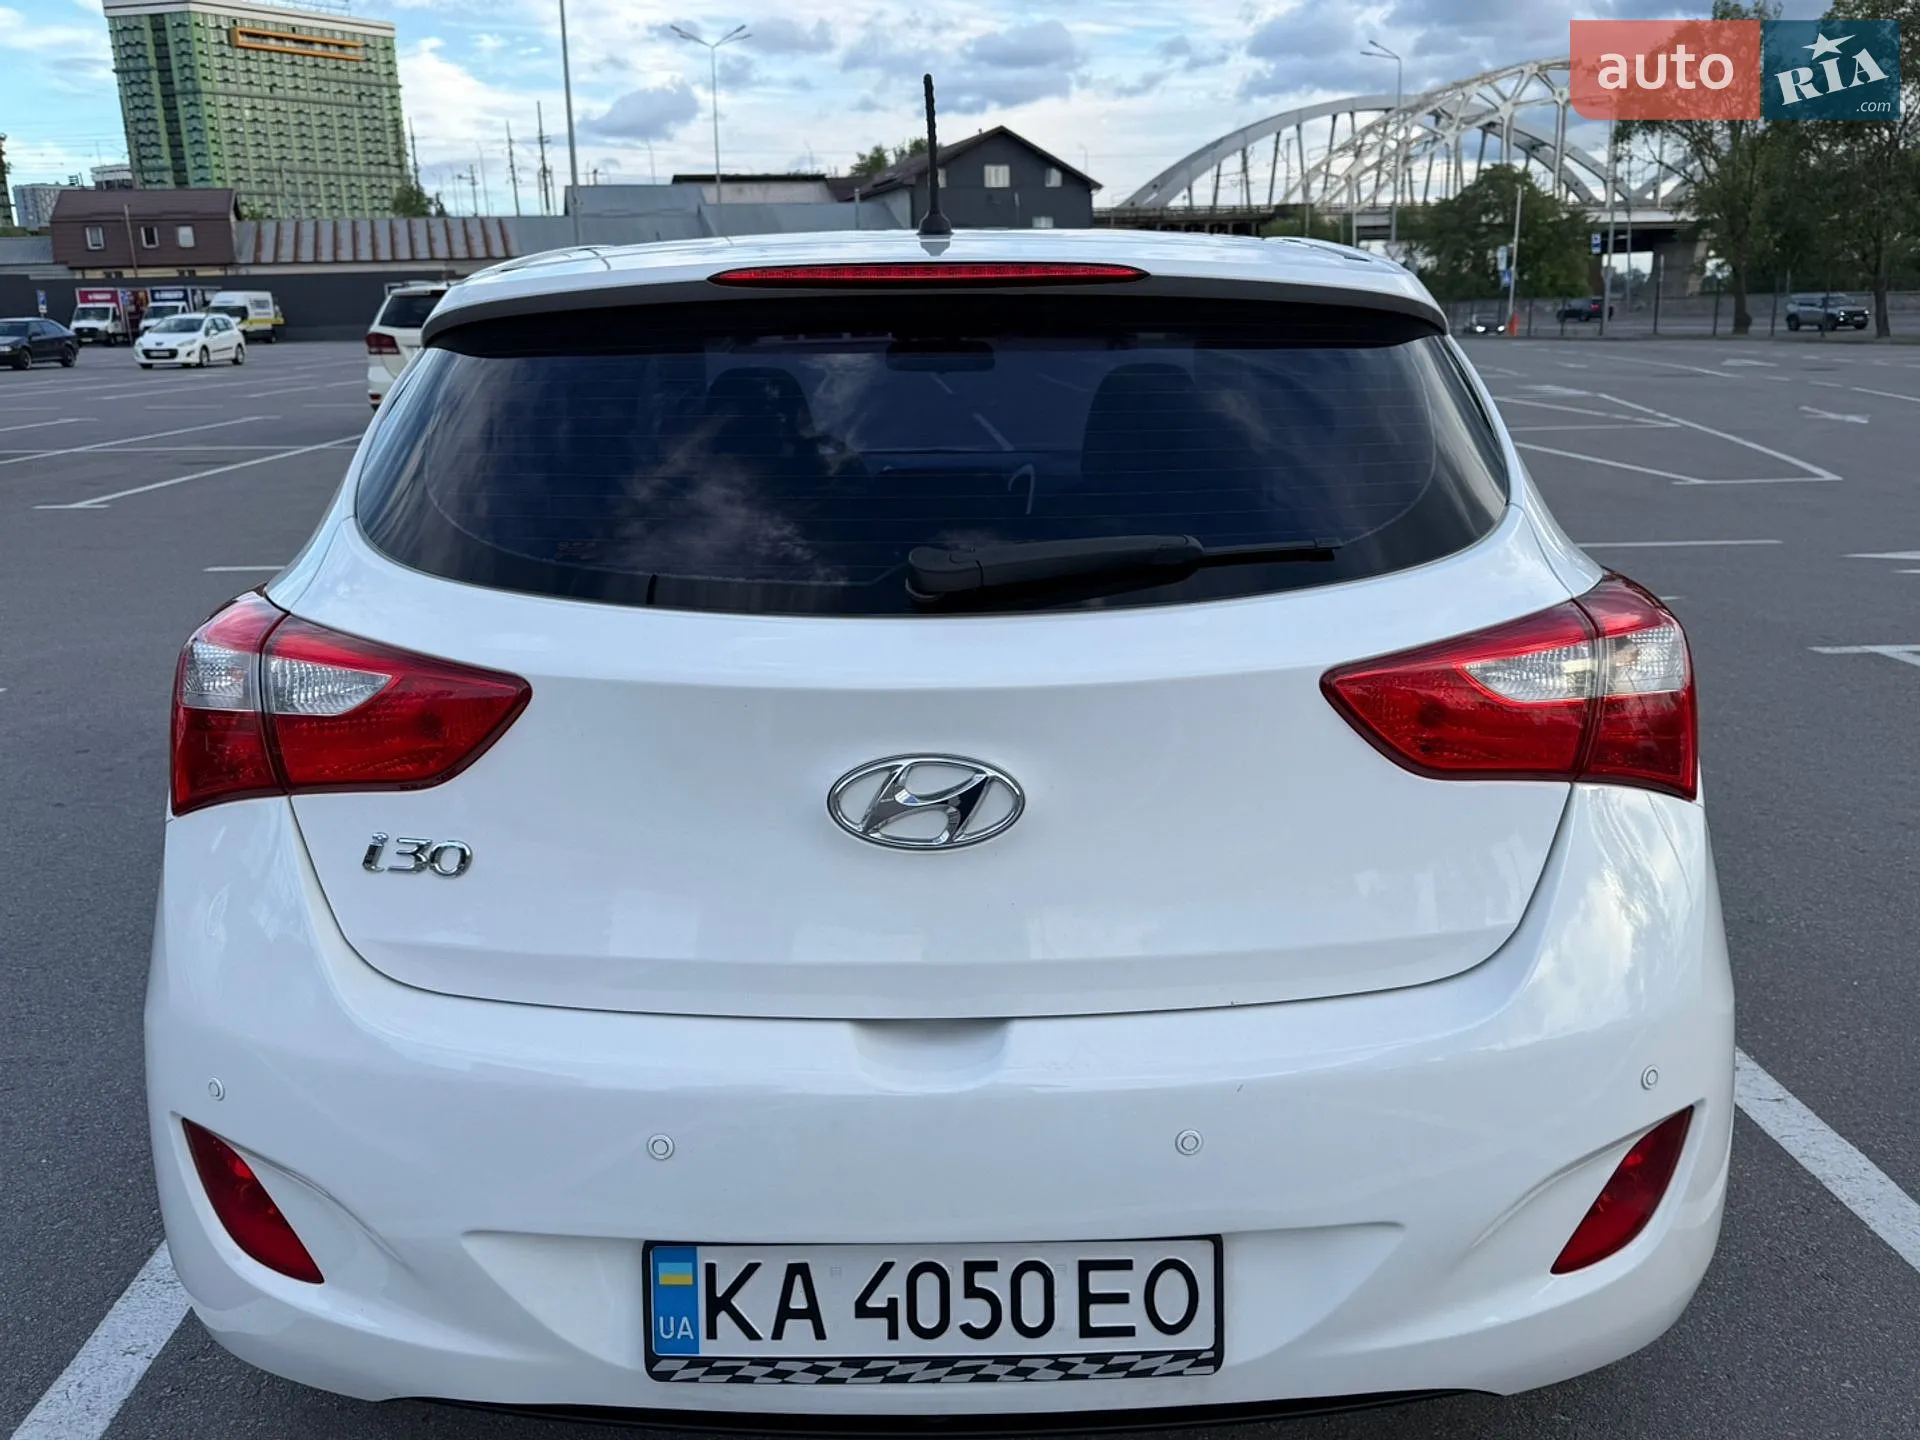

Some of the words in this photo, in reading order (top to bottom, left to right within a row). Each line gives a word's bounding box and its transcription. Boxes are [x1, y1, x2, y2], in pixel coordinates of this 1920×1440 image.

[362, 832, 473, 878] i30
[704, 1261, 827, 1341] KA
[854, 1259, 1055, 1340] 4050
[1077, 1258, 1200, 1338] EO
[659, 1316, 694, 1340] UA
